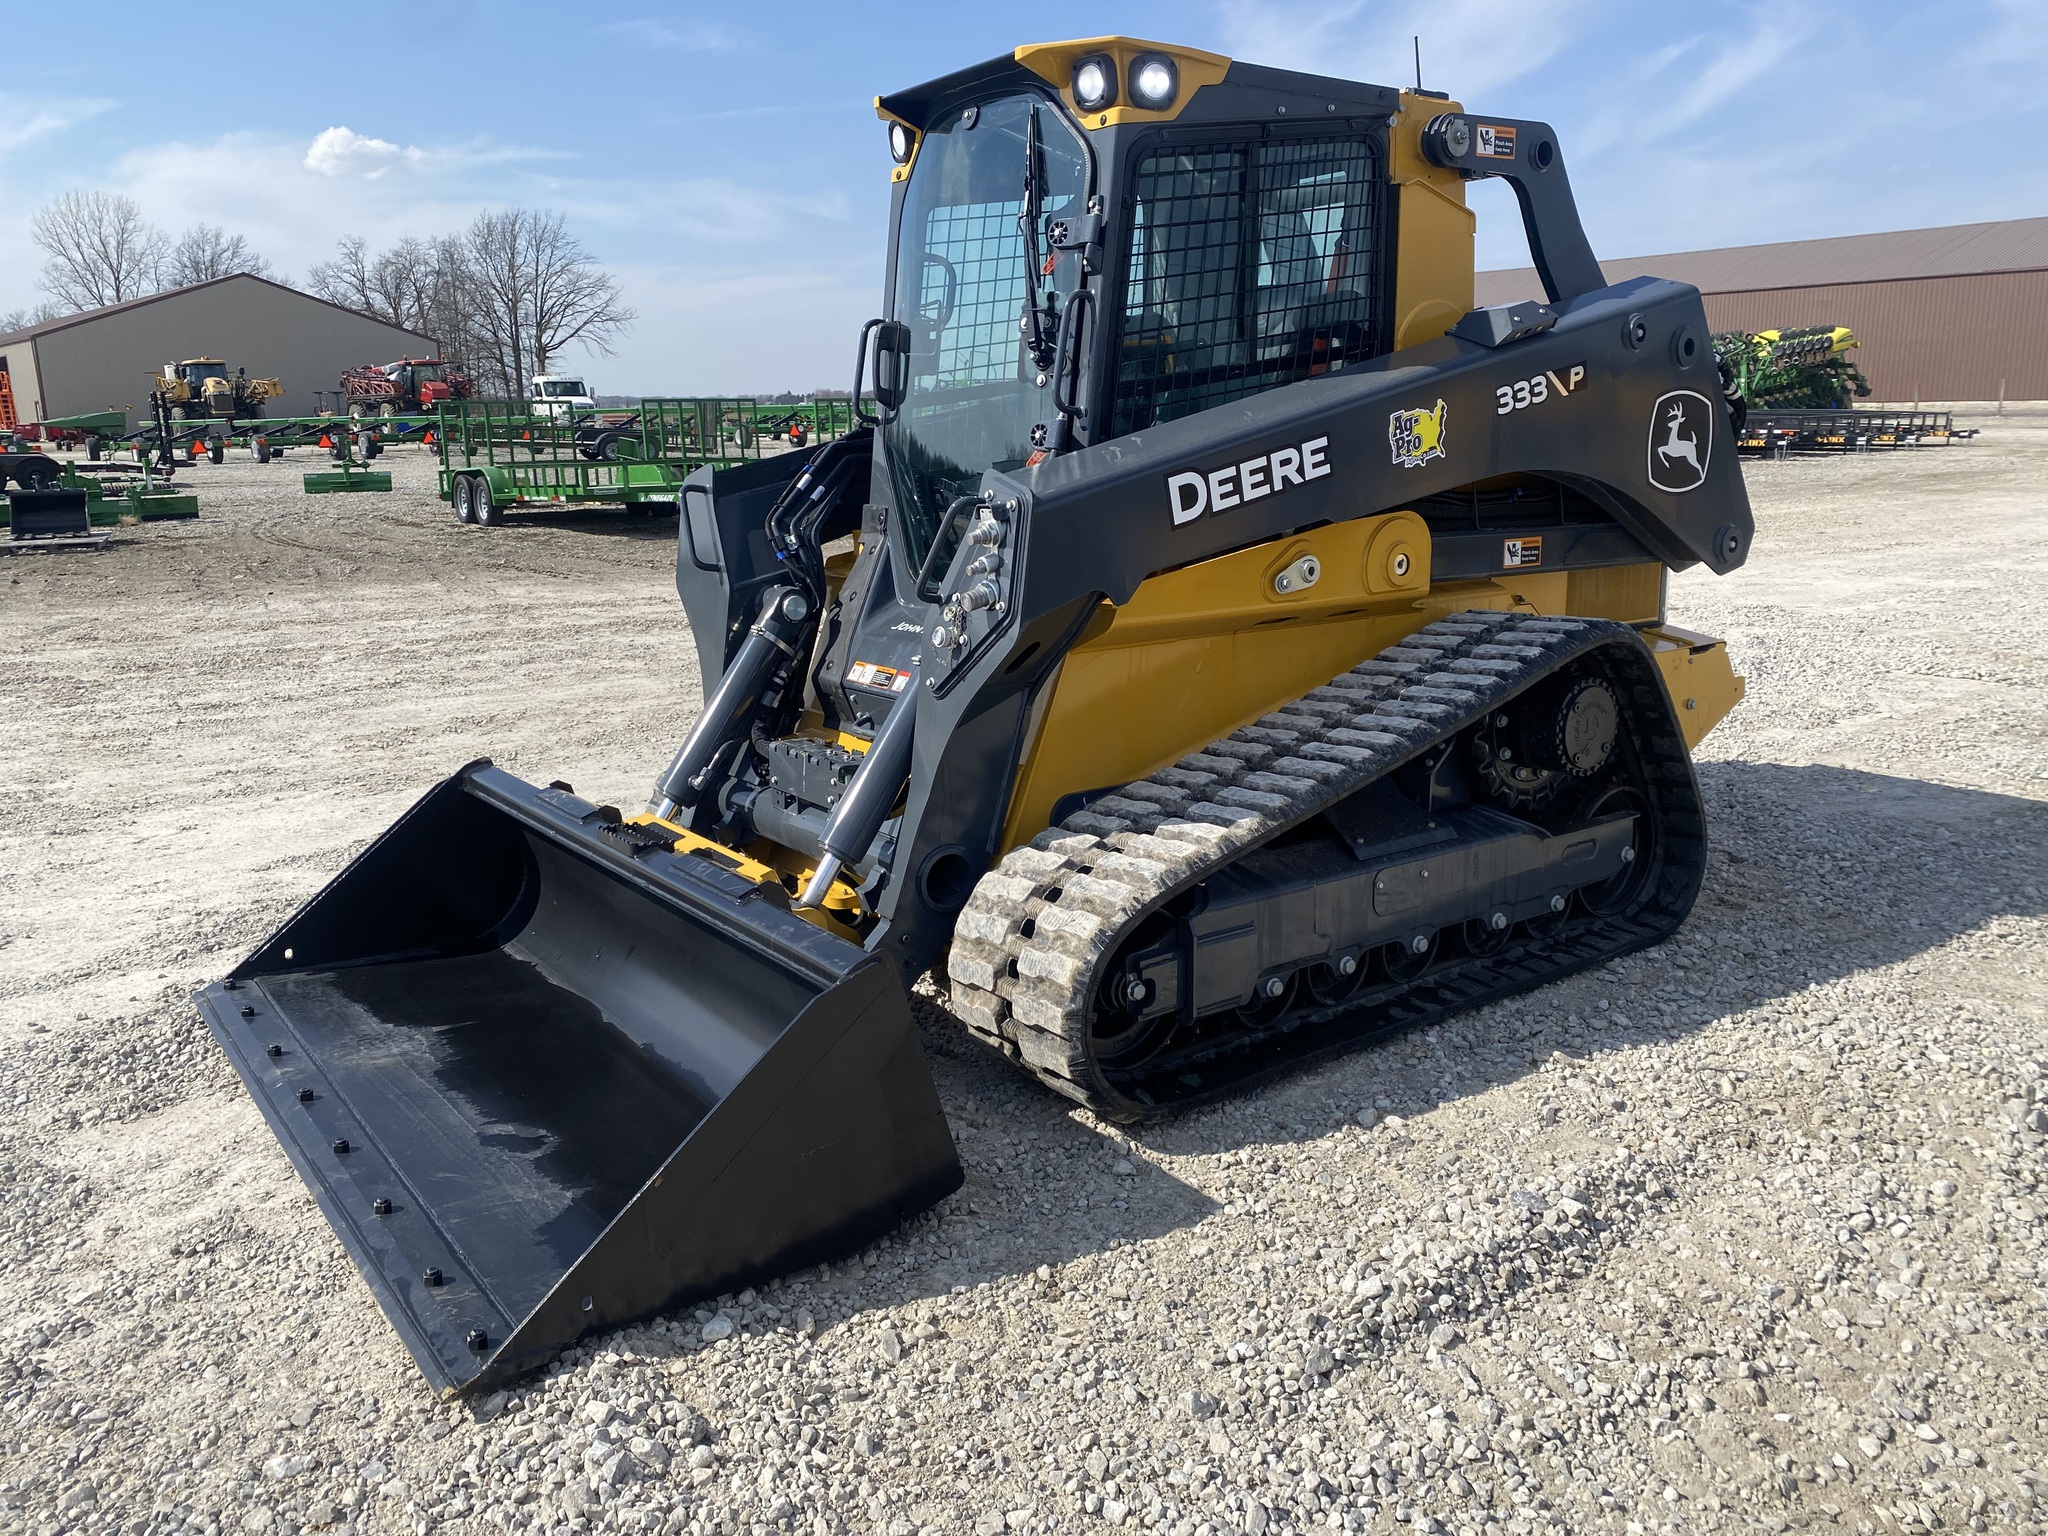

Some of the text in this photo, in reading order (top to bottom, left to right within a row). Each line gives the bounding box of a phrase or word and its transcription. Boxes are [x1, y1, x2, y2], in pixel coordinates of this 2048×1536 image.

[1496, 375, 1548, 415] 333
[1393, 414, 1420, 438] Ag-
[1394, 434, 1422, 459] Pro
[1168, 436, 1331, 525] DEERE
[890, 621, 924, 633] JOHN
